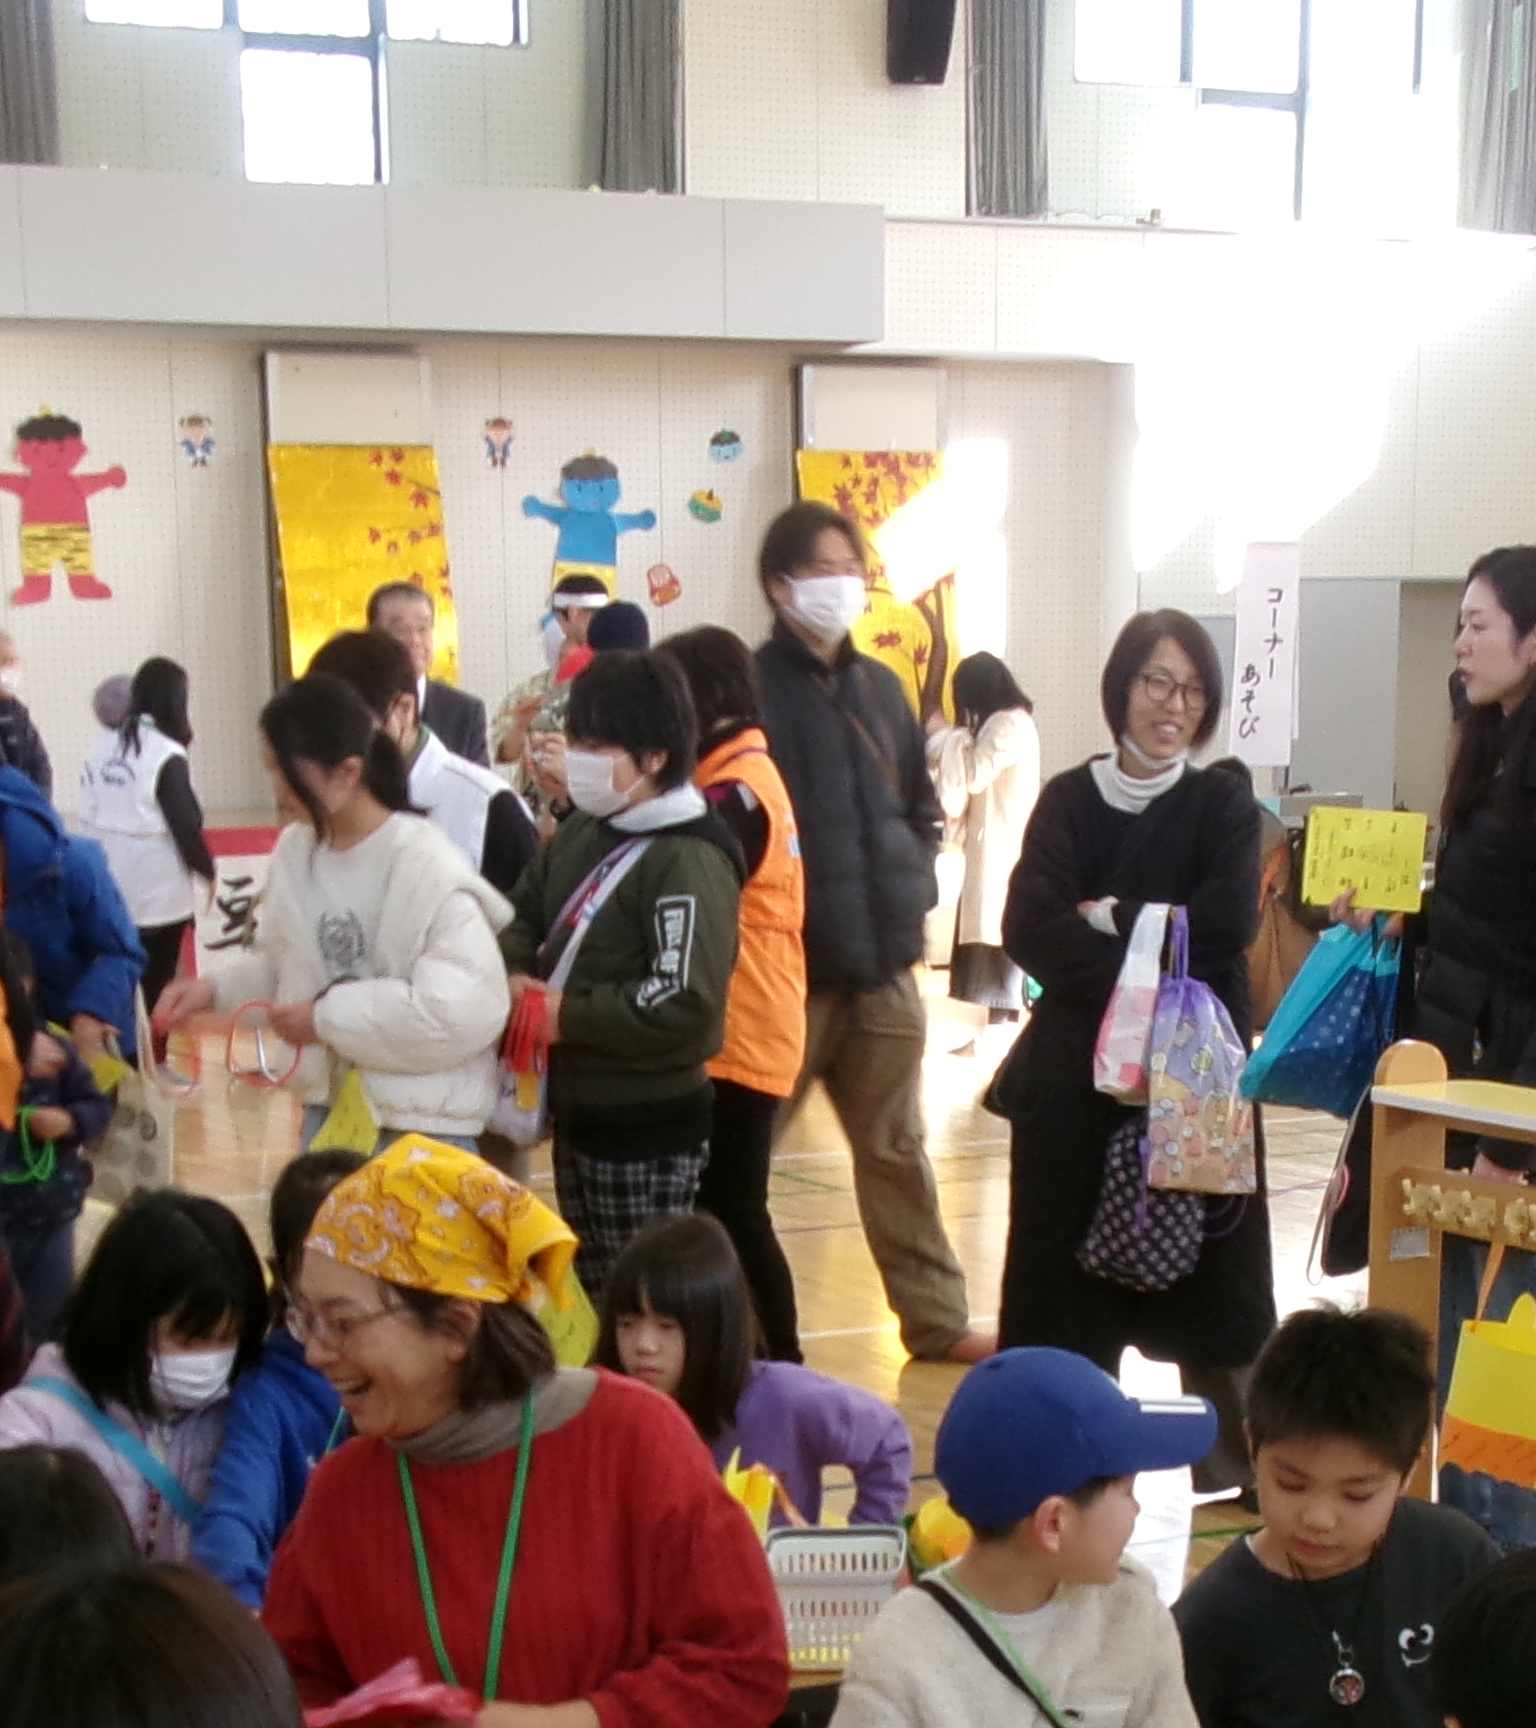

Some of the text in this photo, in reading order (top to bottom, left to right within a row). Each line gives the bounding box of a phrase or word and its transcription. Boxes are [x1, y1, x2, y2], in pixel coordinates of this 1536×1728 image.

[1263, 587, 1284, 680] コーナー
[1238, 662, 1262, 739] あそび
